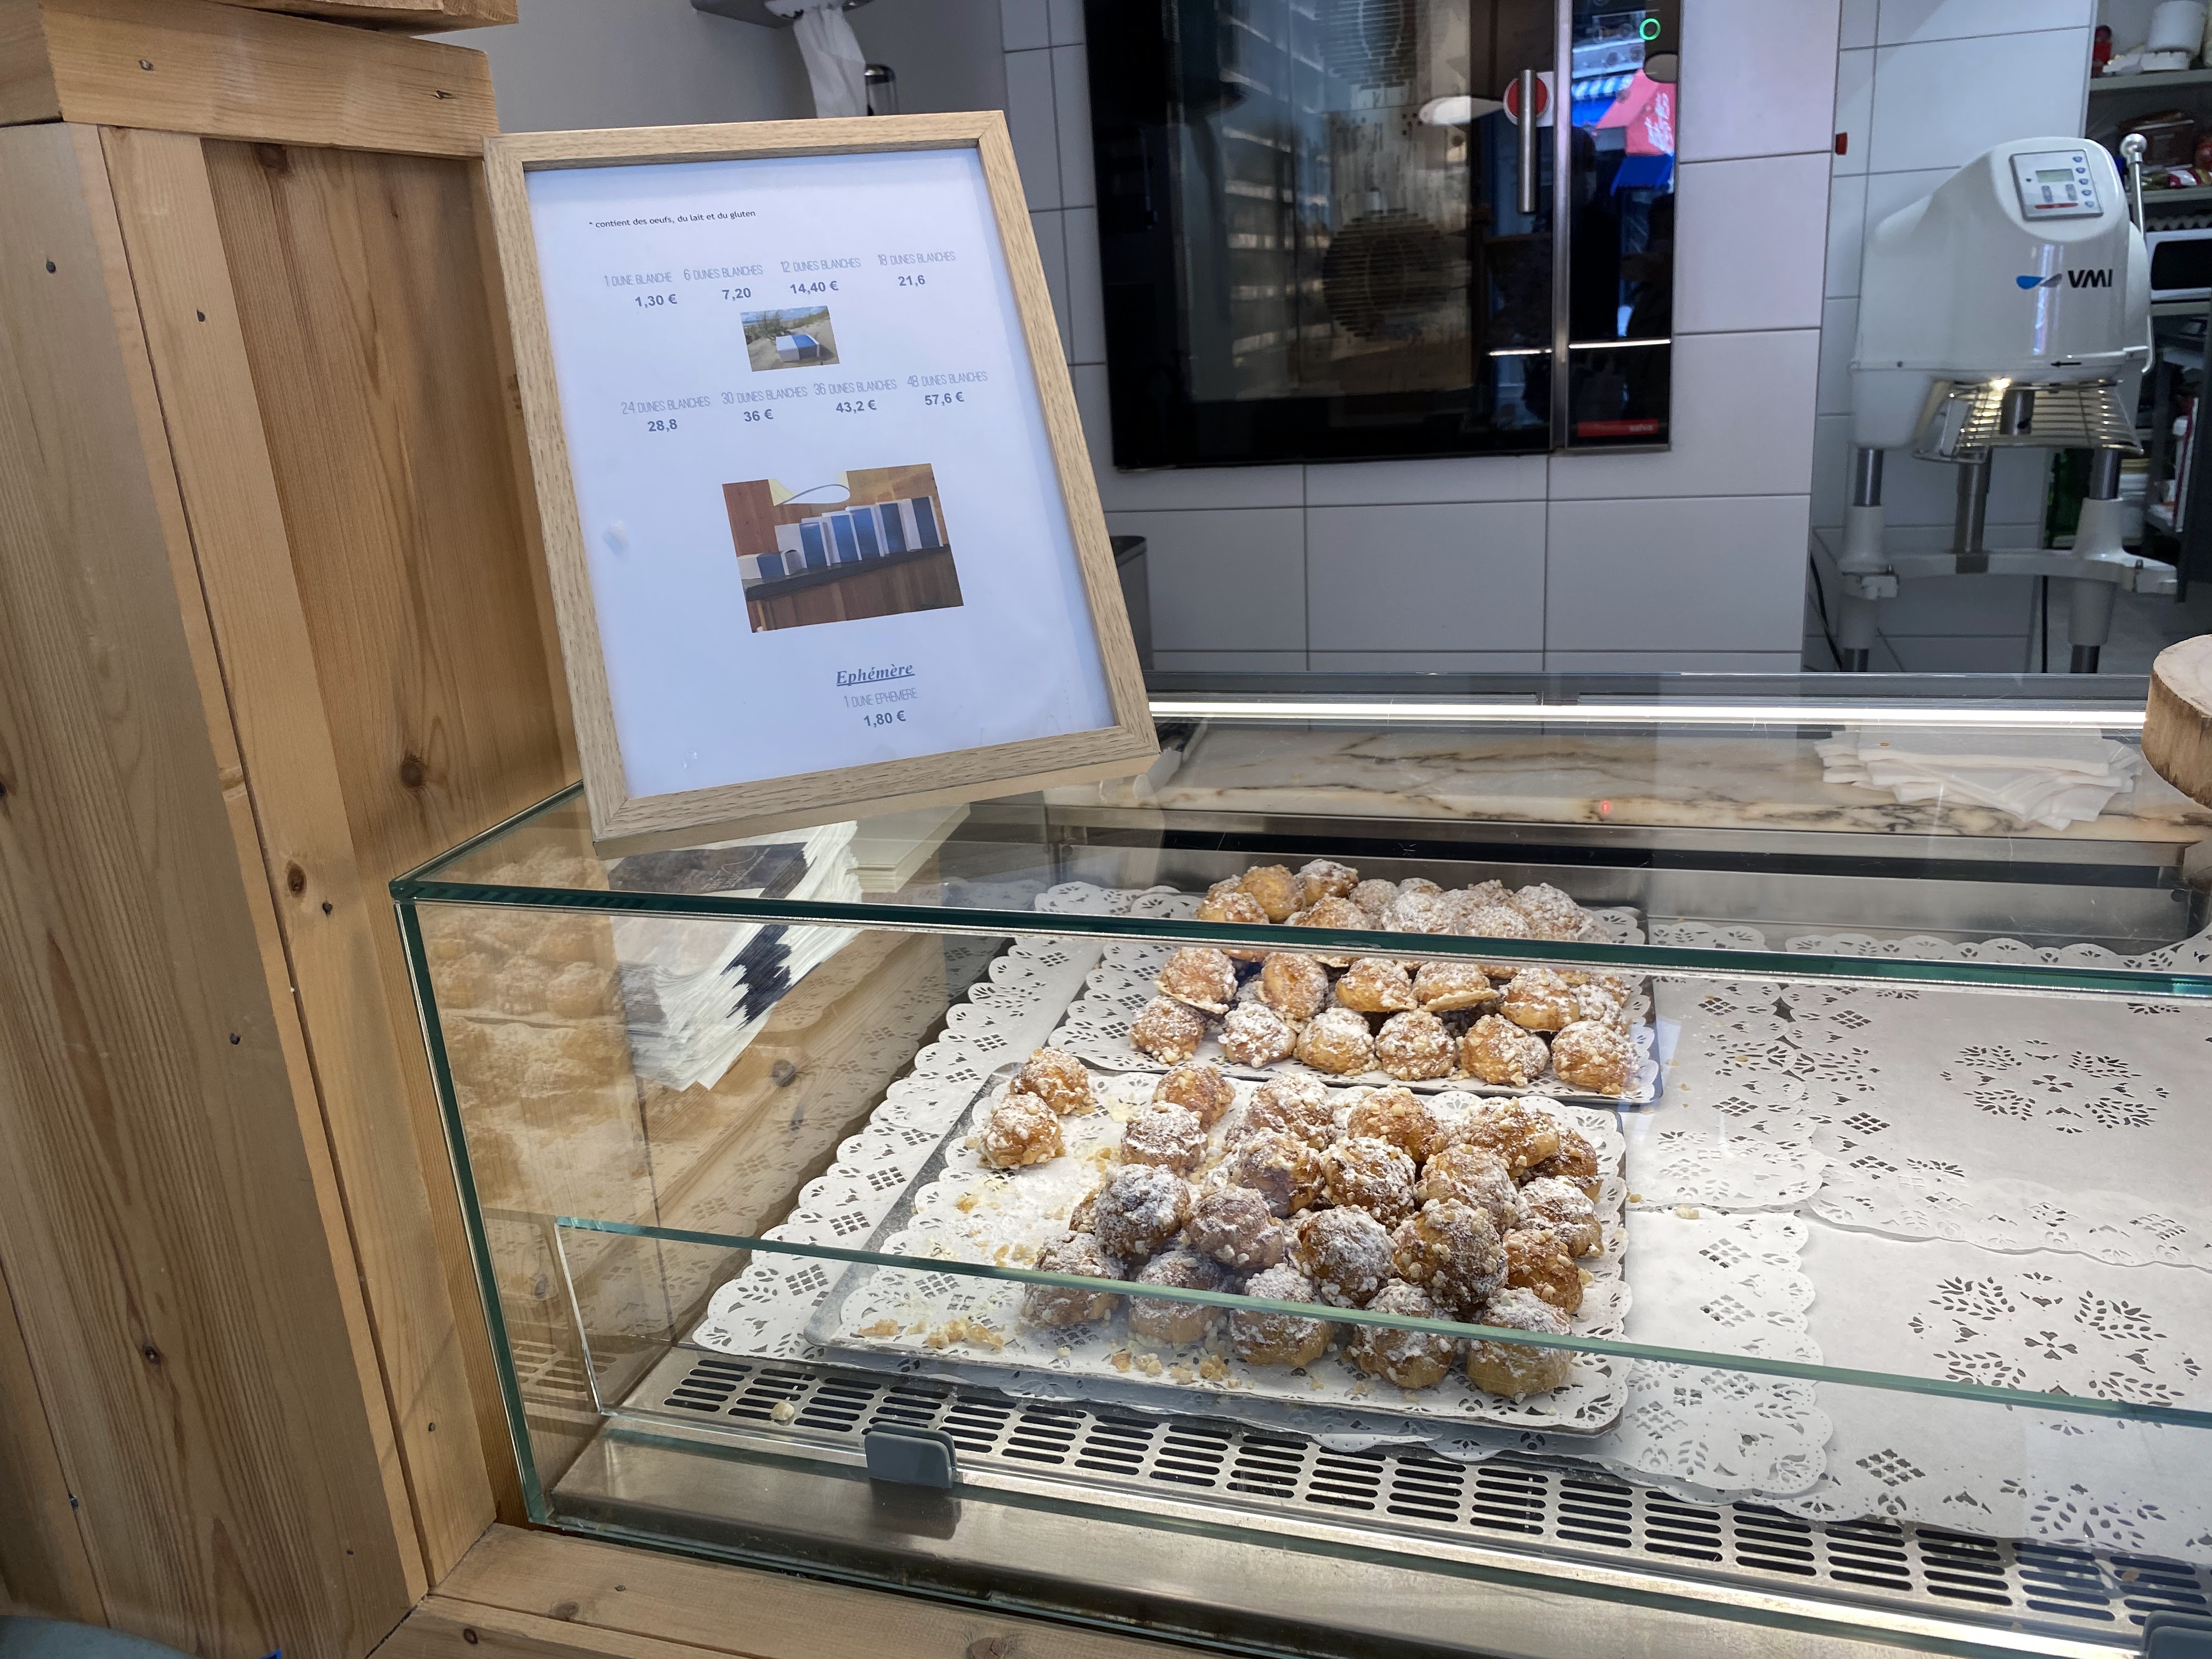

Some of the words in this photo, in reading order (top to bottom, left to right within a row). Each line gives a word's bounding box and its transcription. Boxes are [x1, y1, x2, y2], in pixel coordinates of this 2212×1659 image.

[595, 219, 630, 228] contient
[633, 218, 647, 226] des
[650, 216, 675, 225] oeufs,
[677, 215, 688, 223] du
[690, 213, 704, 222] lait
[717, 212, 728, 220] du
[730, 210, 756, 219] gluten
[780, 260, 791, 273] 12
[793, 260, 819, 273] DUNES
[820, 257, 861, 270] BLANCHES
[877, 253, 888, 266] 18
[889, 253, 916, 265] DUNES
[916, 250, 956, 263] BLANCHES
[604, 274, 610, 287] 1
[611, 274, 634, 286] DUNE
[635, 271, 673, 285] BLANCHE
[683, 268, 691, 280] 6
[693, 268, 720, 280] DUNES
[721, 264, 764, 278] BLANCHES
[2068, 268, 2114, 289] VMI
[789, 281, 826, 295] 14,40
[829, 280, 839, 291] €
[898, 274, 926, 287] 21,6
[635, 294, 665, 308] 1,30
[668, 293, 678, 305] €
[721, 287, 752, 302] 7,20
[813, 383, 826, 396] 36
[828, 382, 855, 394] DUNES
[856, 379, 898, 392] BLANCHES
[907, 374, 919, 388] 48
[921, 374, 947, 387] DUNES
[948, 371, 988, 385] BLANCHES
[721, 391, 734, 405] 30
[737, 390, 765, 404] DUNES
[765, 386, 808, 400] BLANCHES
[924, 393, 952, 407] 57,6
[955, 391, 964, 403] €
[620, 401, 636, 415] 24
[637, 400, 665, 413] DUNES
[667, 396, 711, 411] BLANCHES
[836, 400, 865, 414] 43,2
[868, 399, 877, 411] €
[743, 410, 760, 422] 36
[764, 408, 774, 420] €
[647, 418, 678, 432] 28,8
[836, 663, 915, 686] Ephémère
[844, 695, 850, 708] 1
[851, 694, 874, 708] DUNE
[875, 687, 918, 704] EPHEMERE
[864, 712, 893, 728] 1,80
[896, 710, 906, 722] €
